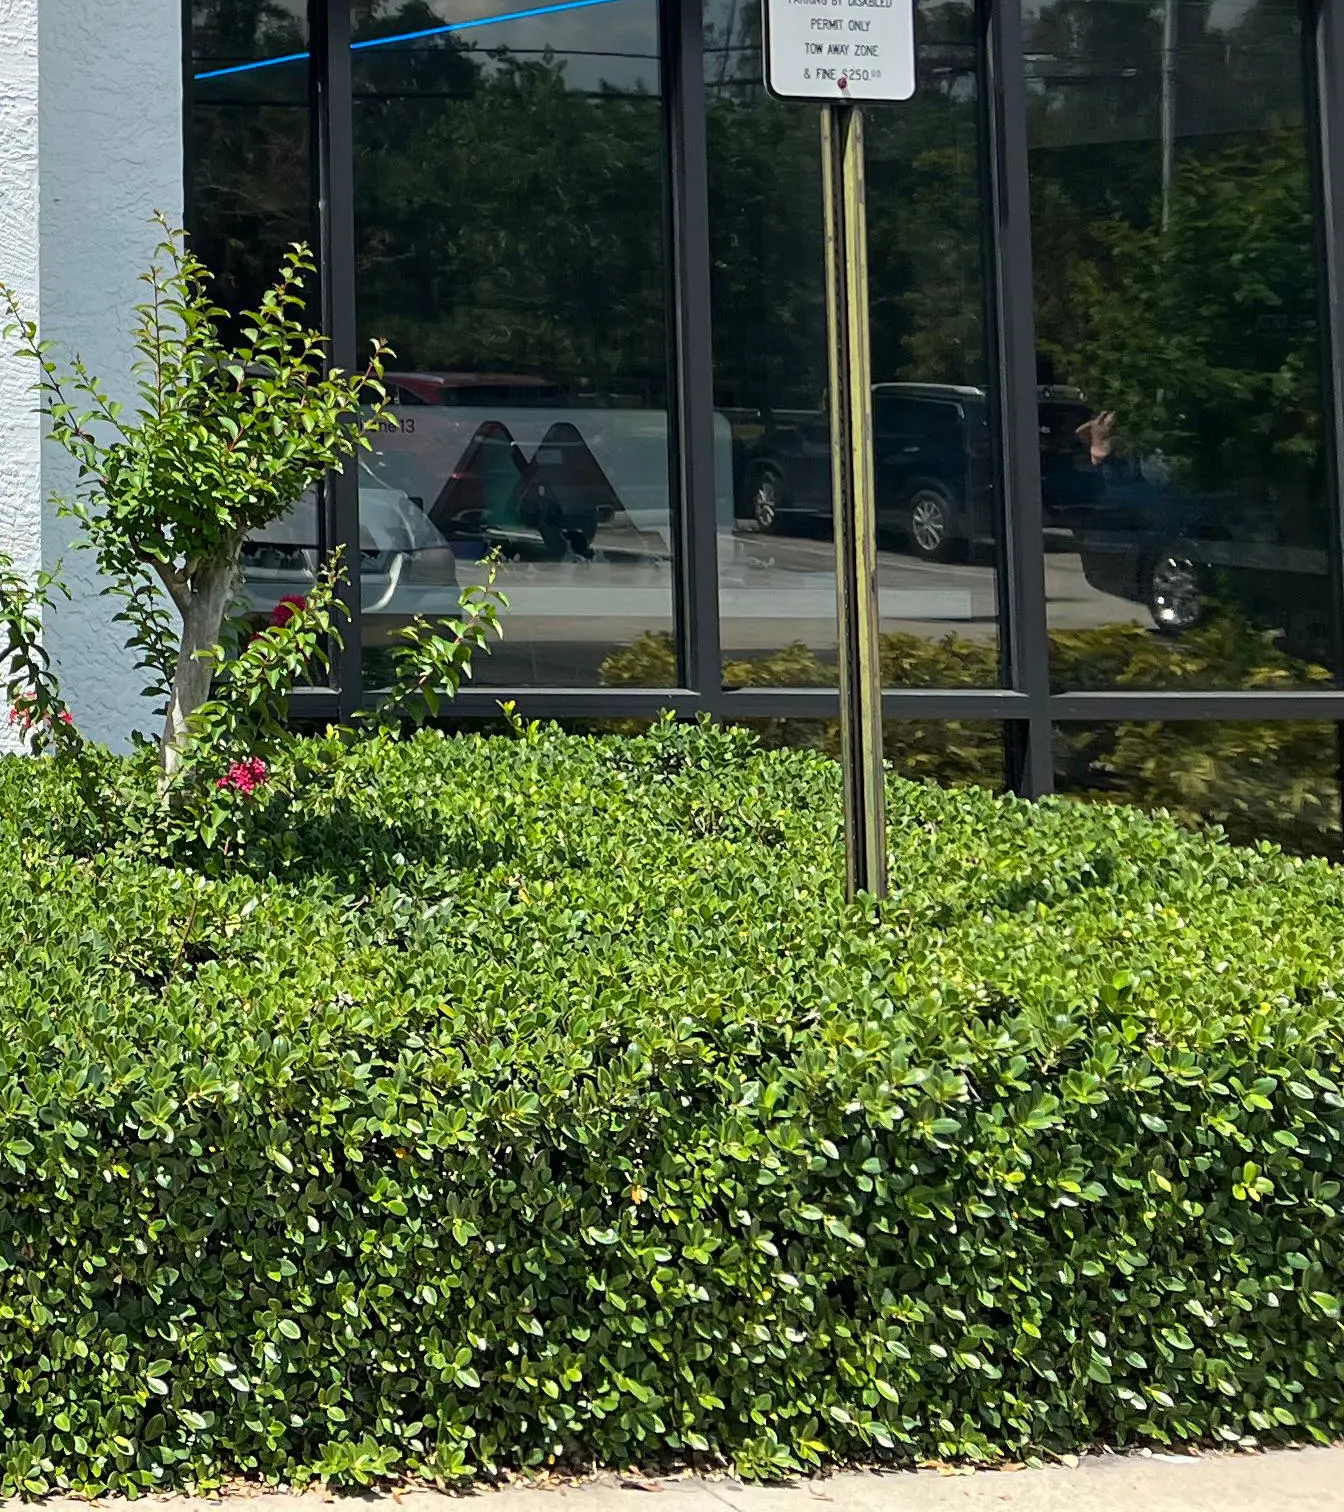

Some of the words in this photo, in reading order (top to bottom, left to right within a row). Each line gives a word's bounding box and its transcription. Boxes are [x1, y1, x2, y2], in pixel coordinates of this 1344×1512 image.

[810, 18, 844, 31] PERMIT
[848, 19, 872, 32] ONLY
[804, 42, 823, 55] TOW
[827, 44, 849, 56] AWAY
[854, 44, 879, 57] ZONE
[803, 68, 811, 80] &
[816, 68, 836, 81] FINE
[398, 418, 416, 434] 13
